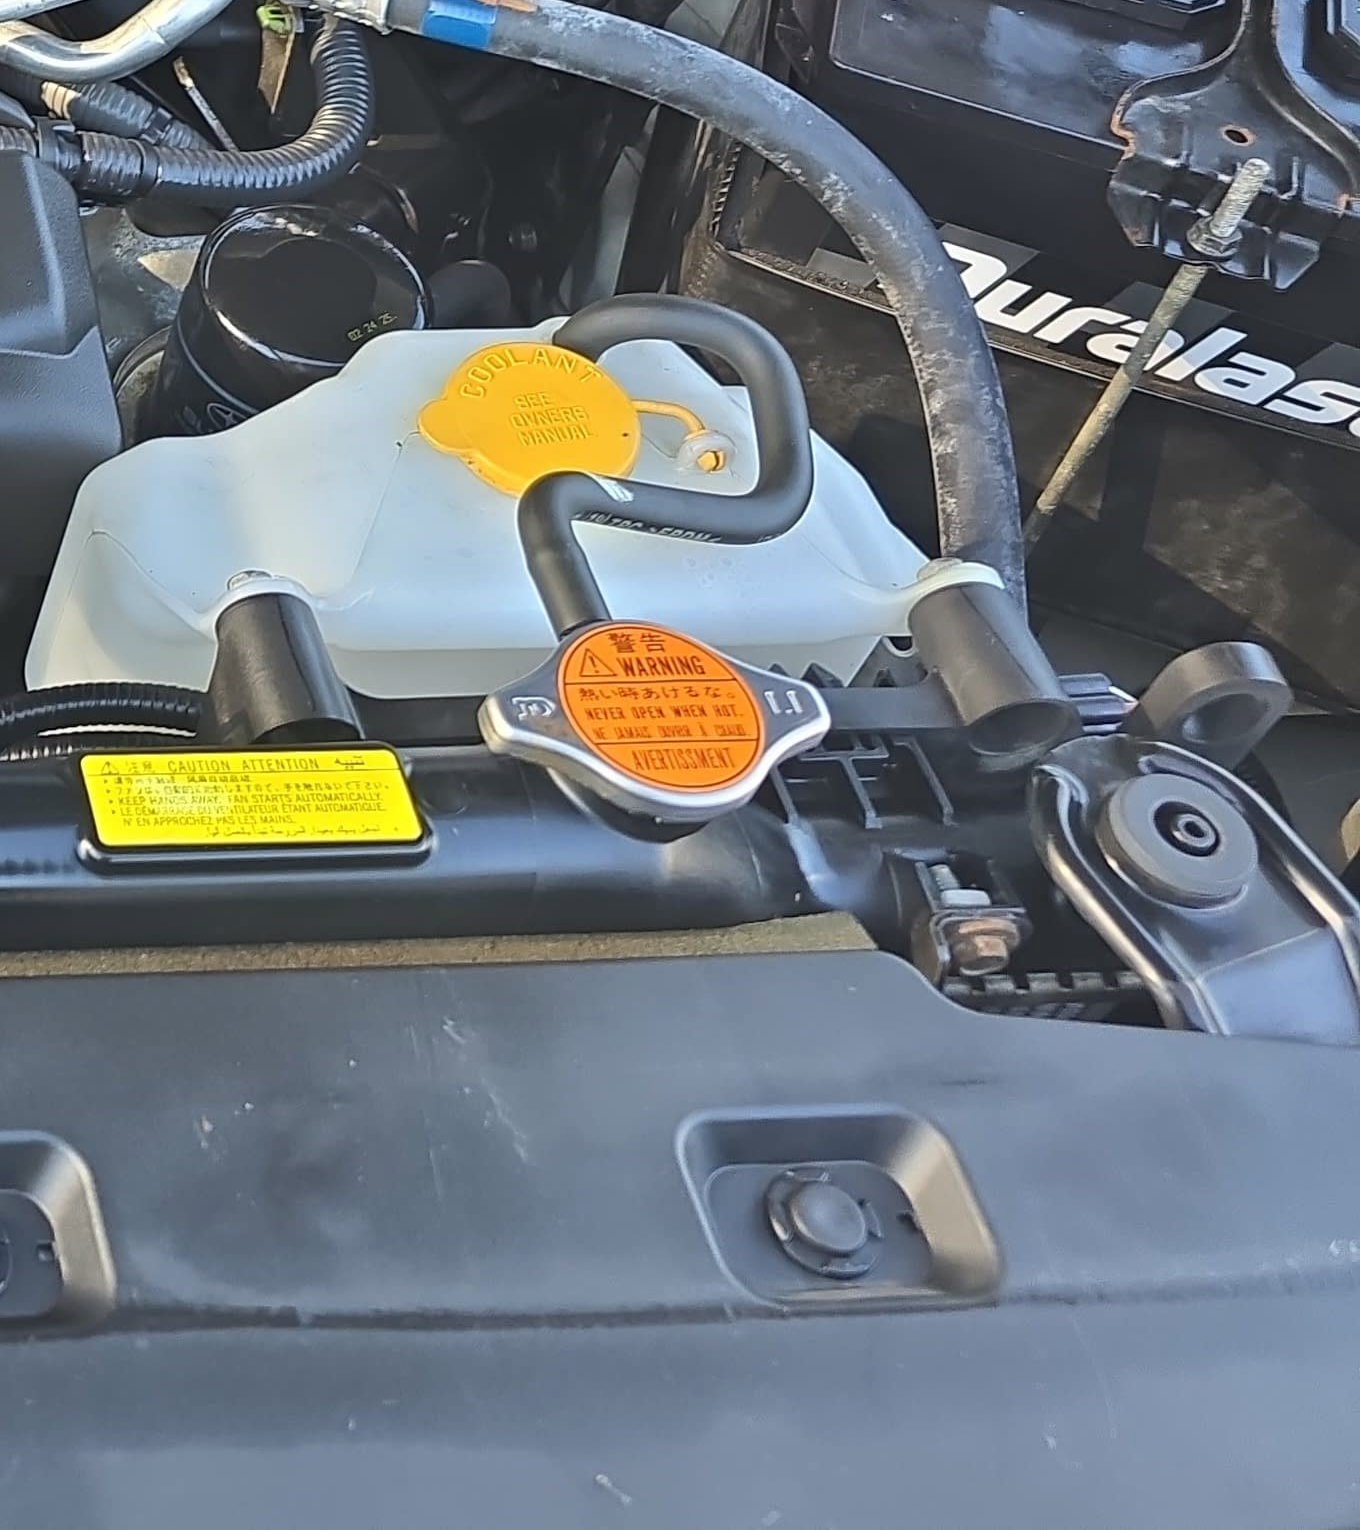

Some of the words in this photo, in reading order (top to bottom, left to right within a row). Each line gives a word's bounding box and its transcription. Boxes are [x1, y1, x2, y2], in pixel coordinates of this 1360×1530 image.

[941, 241, 1360, 438] uralas
[459, 347, 602, 399] COOLANT
[513, 391, 554, 410] SEE
[510, 406, 589, 429] OWNERS
[518, 425, 594, 447] MANUAL
[608, 632, 666, 654] 警告
[616, 655, 706, 677] WARNING
[584, 706, 626, 720] NEVER
[631, 705, 666, 719] OPEN
[669, 704, 708, 718] WHEN
[168, 760, 230, 773] CAUTION
[242, 757, 319, 771] ATTENTION
[118, 796, 145, 805] KEEP
[251, 793, 292, 803] STARTS
[153, 817, 214, 826] APPROCHEZ
[216, 816, 235, 826] PAS
[238, 815, 257, 825] LES
